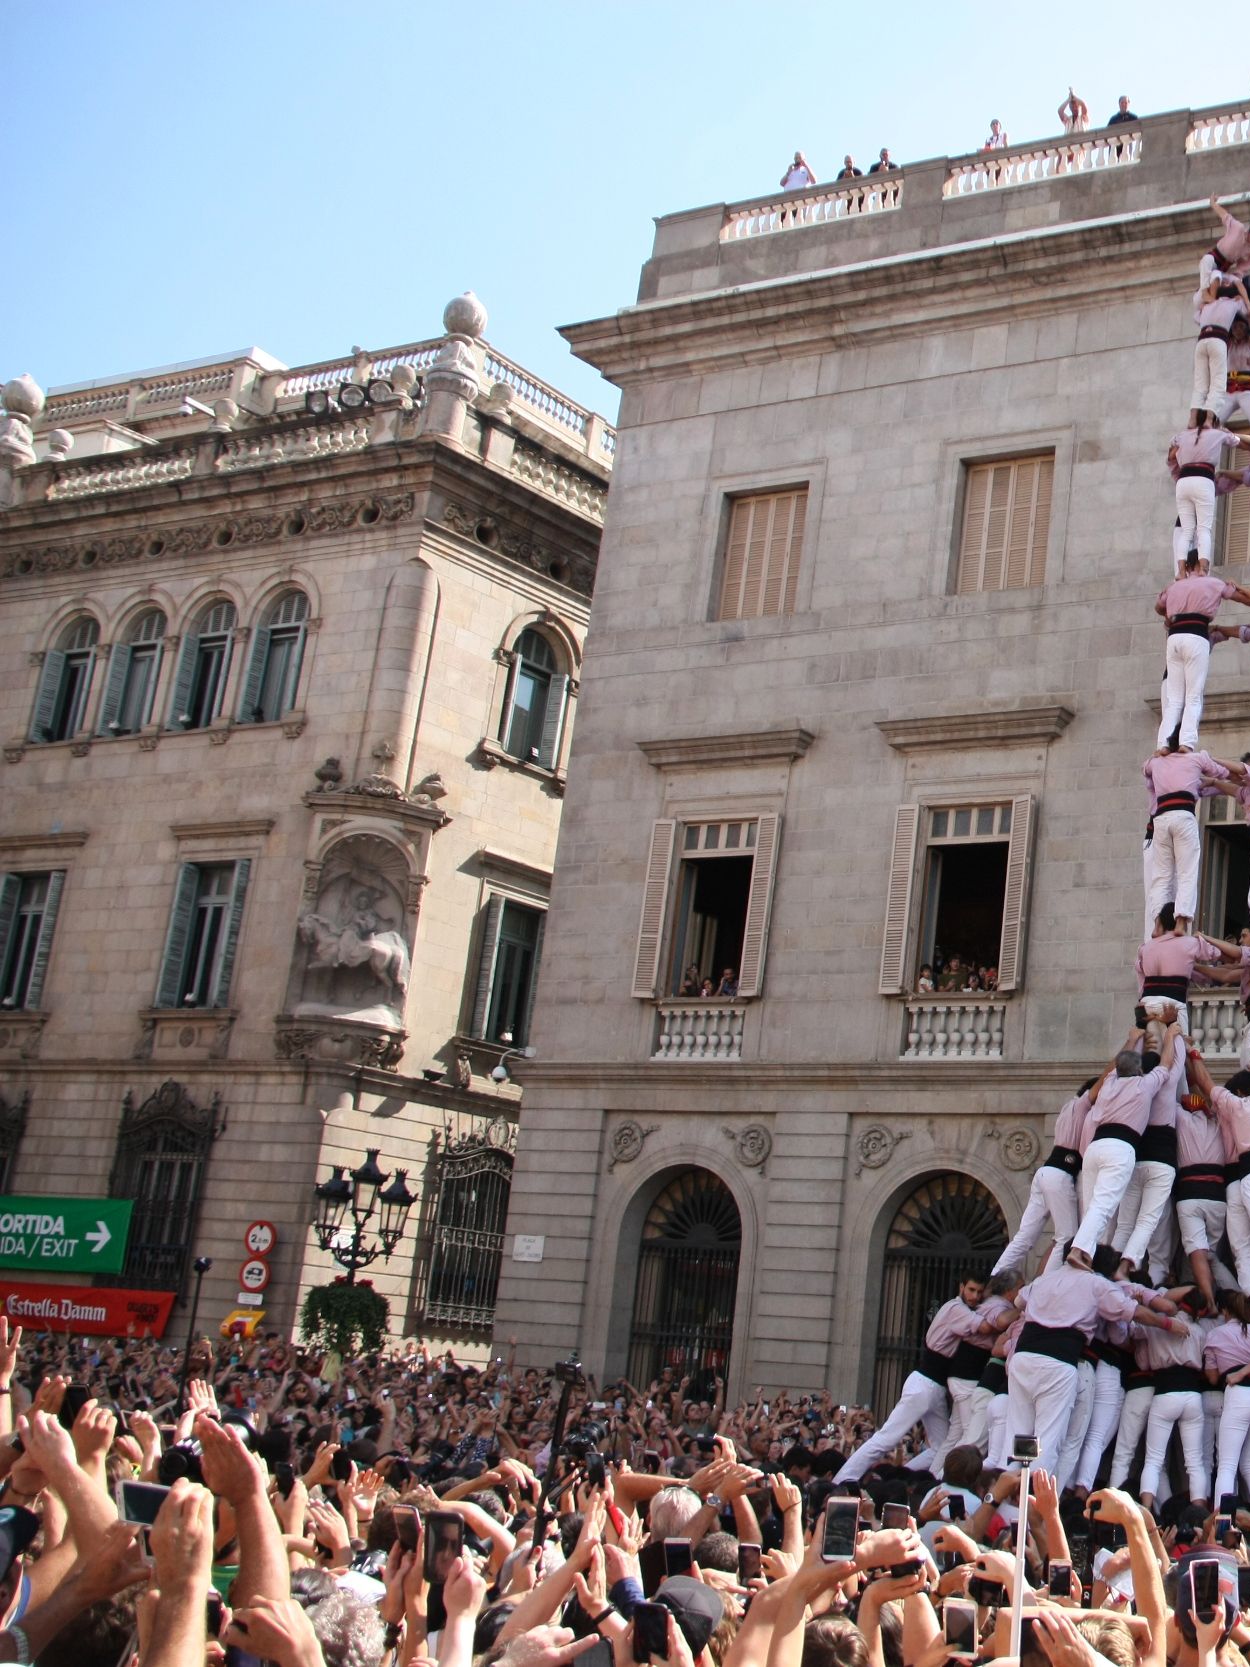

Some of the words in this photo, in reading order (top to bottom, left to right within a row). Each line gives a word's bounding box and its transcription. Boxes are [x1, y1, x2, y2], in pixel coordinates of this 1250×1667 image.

[0, 1213, 65, 1236] ORTIDA
[41, 1238, 79, 1257] EXIT
[6, 1293, 58, 1317] Estrella
[61, 1299, 107, 1322] Damm
